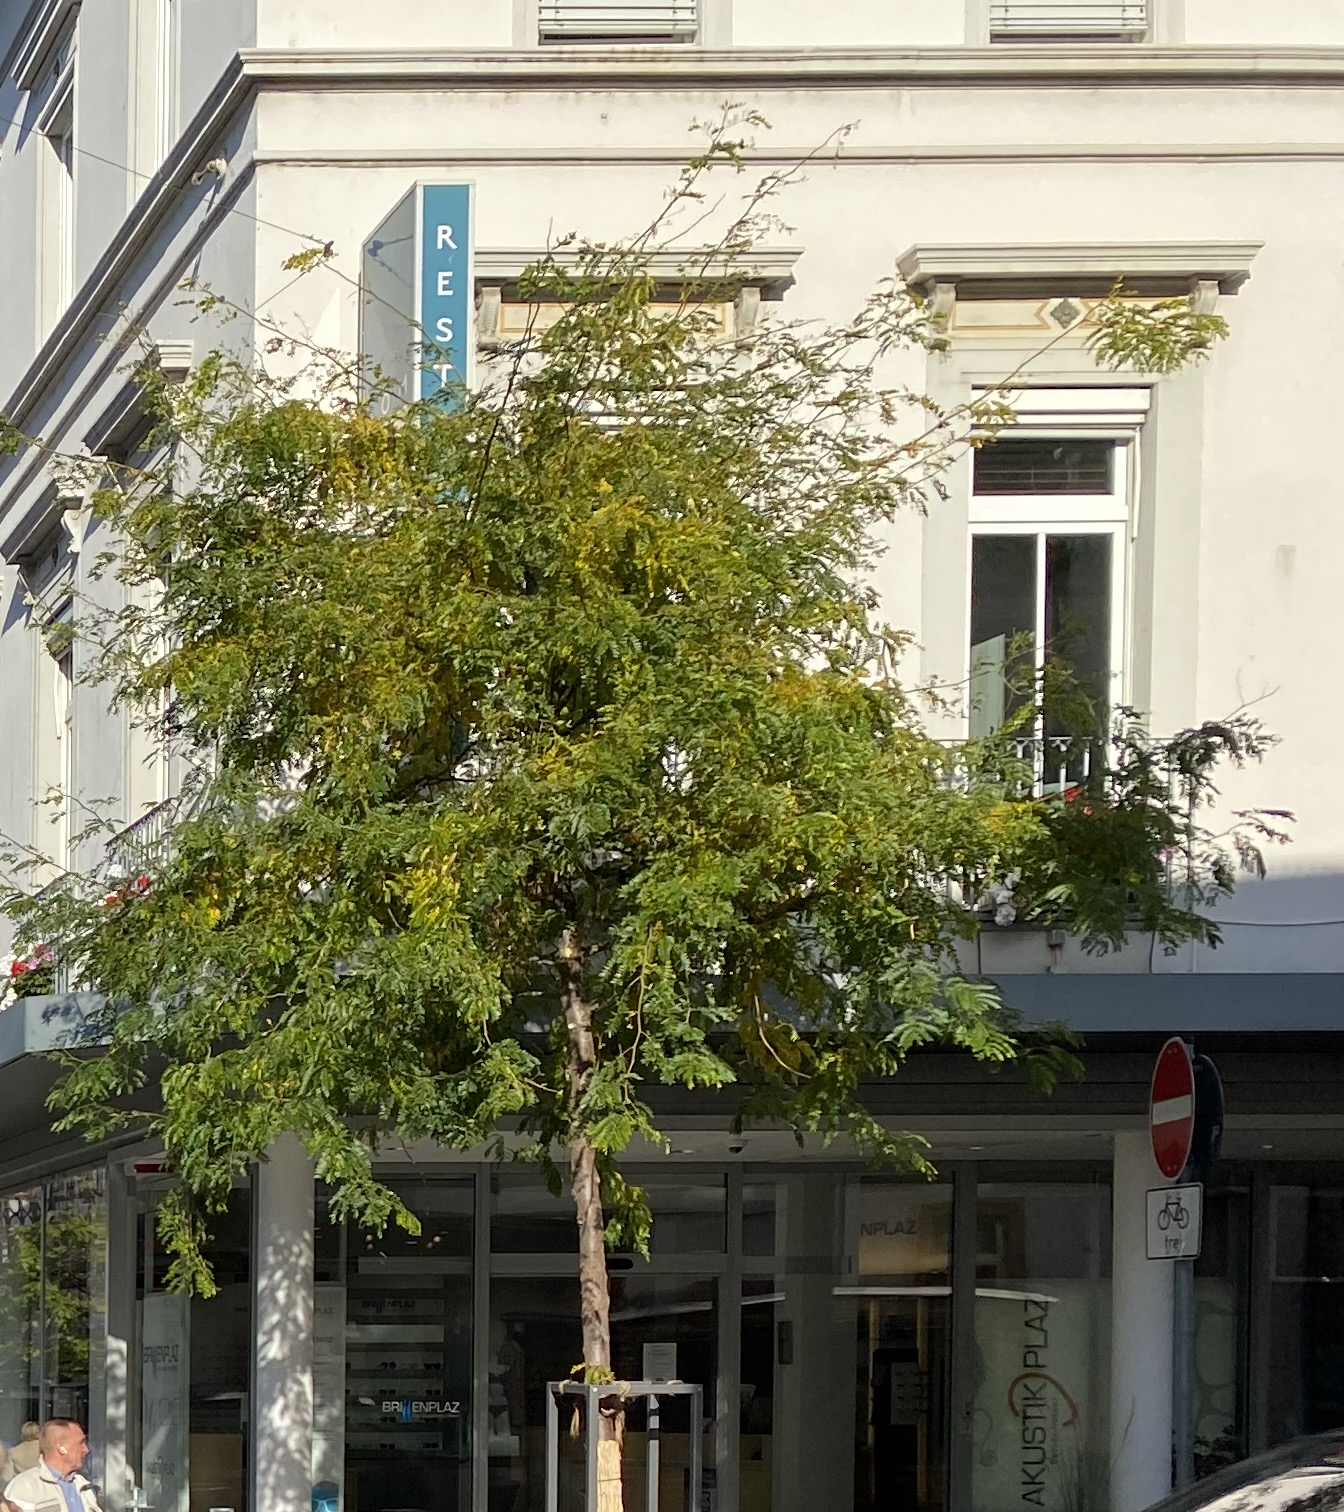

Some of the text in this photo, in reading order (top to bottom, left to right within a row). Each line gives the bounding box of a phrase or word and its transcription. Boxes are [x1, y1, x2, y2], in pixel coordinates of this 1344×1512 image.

[1164, 1233, 1183, 1250] frei
[1021, 1299, 1050, 1507] AKUSTIK PLAZ
